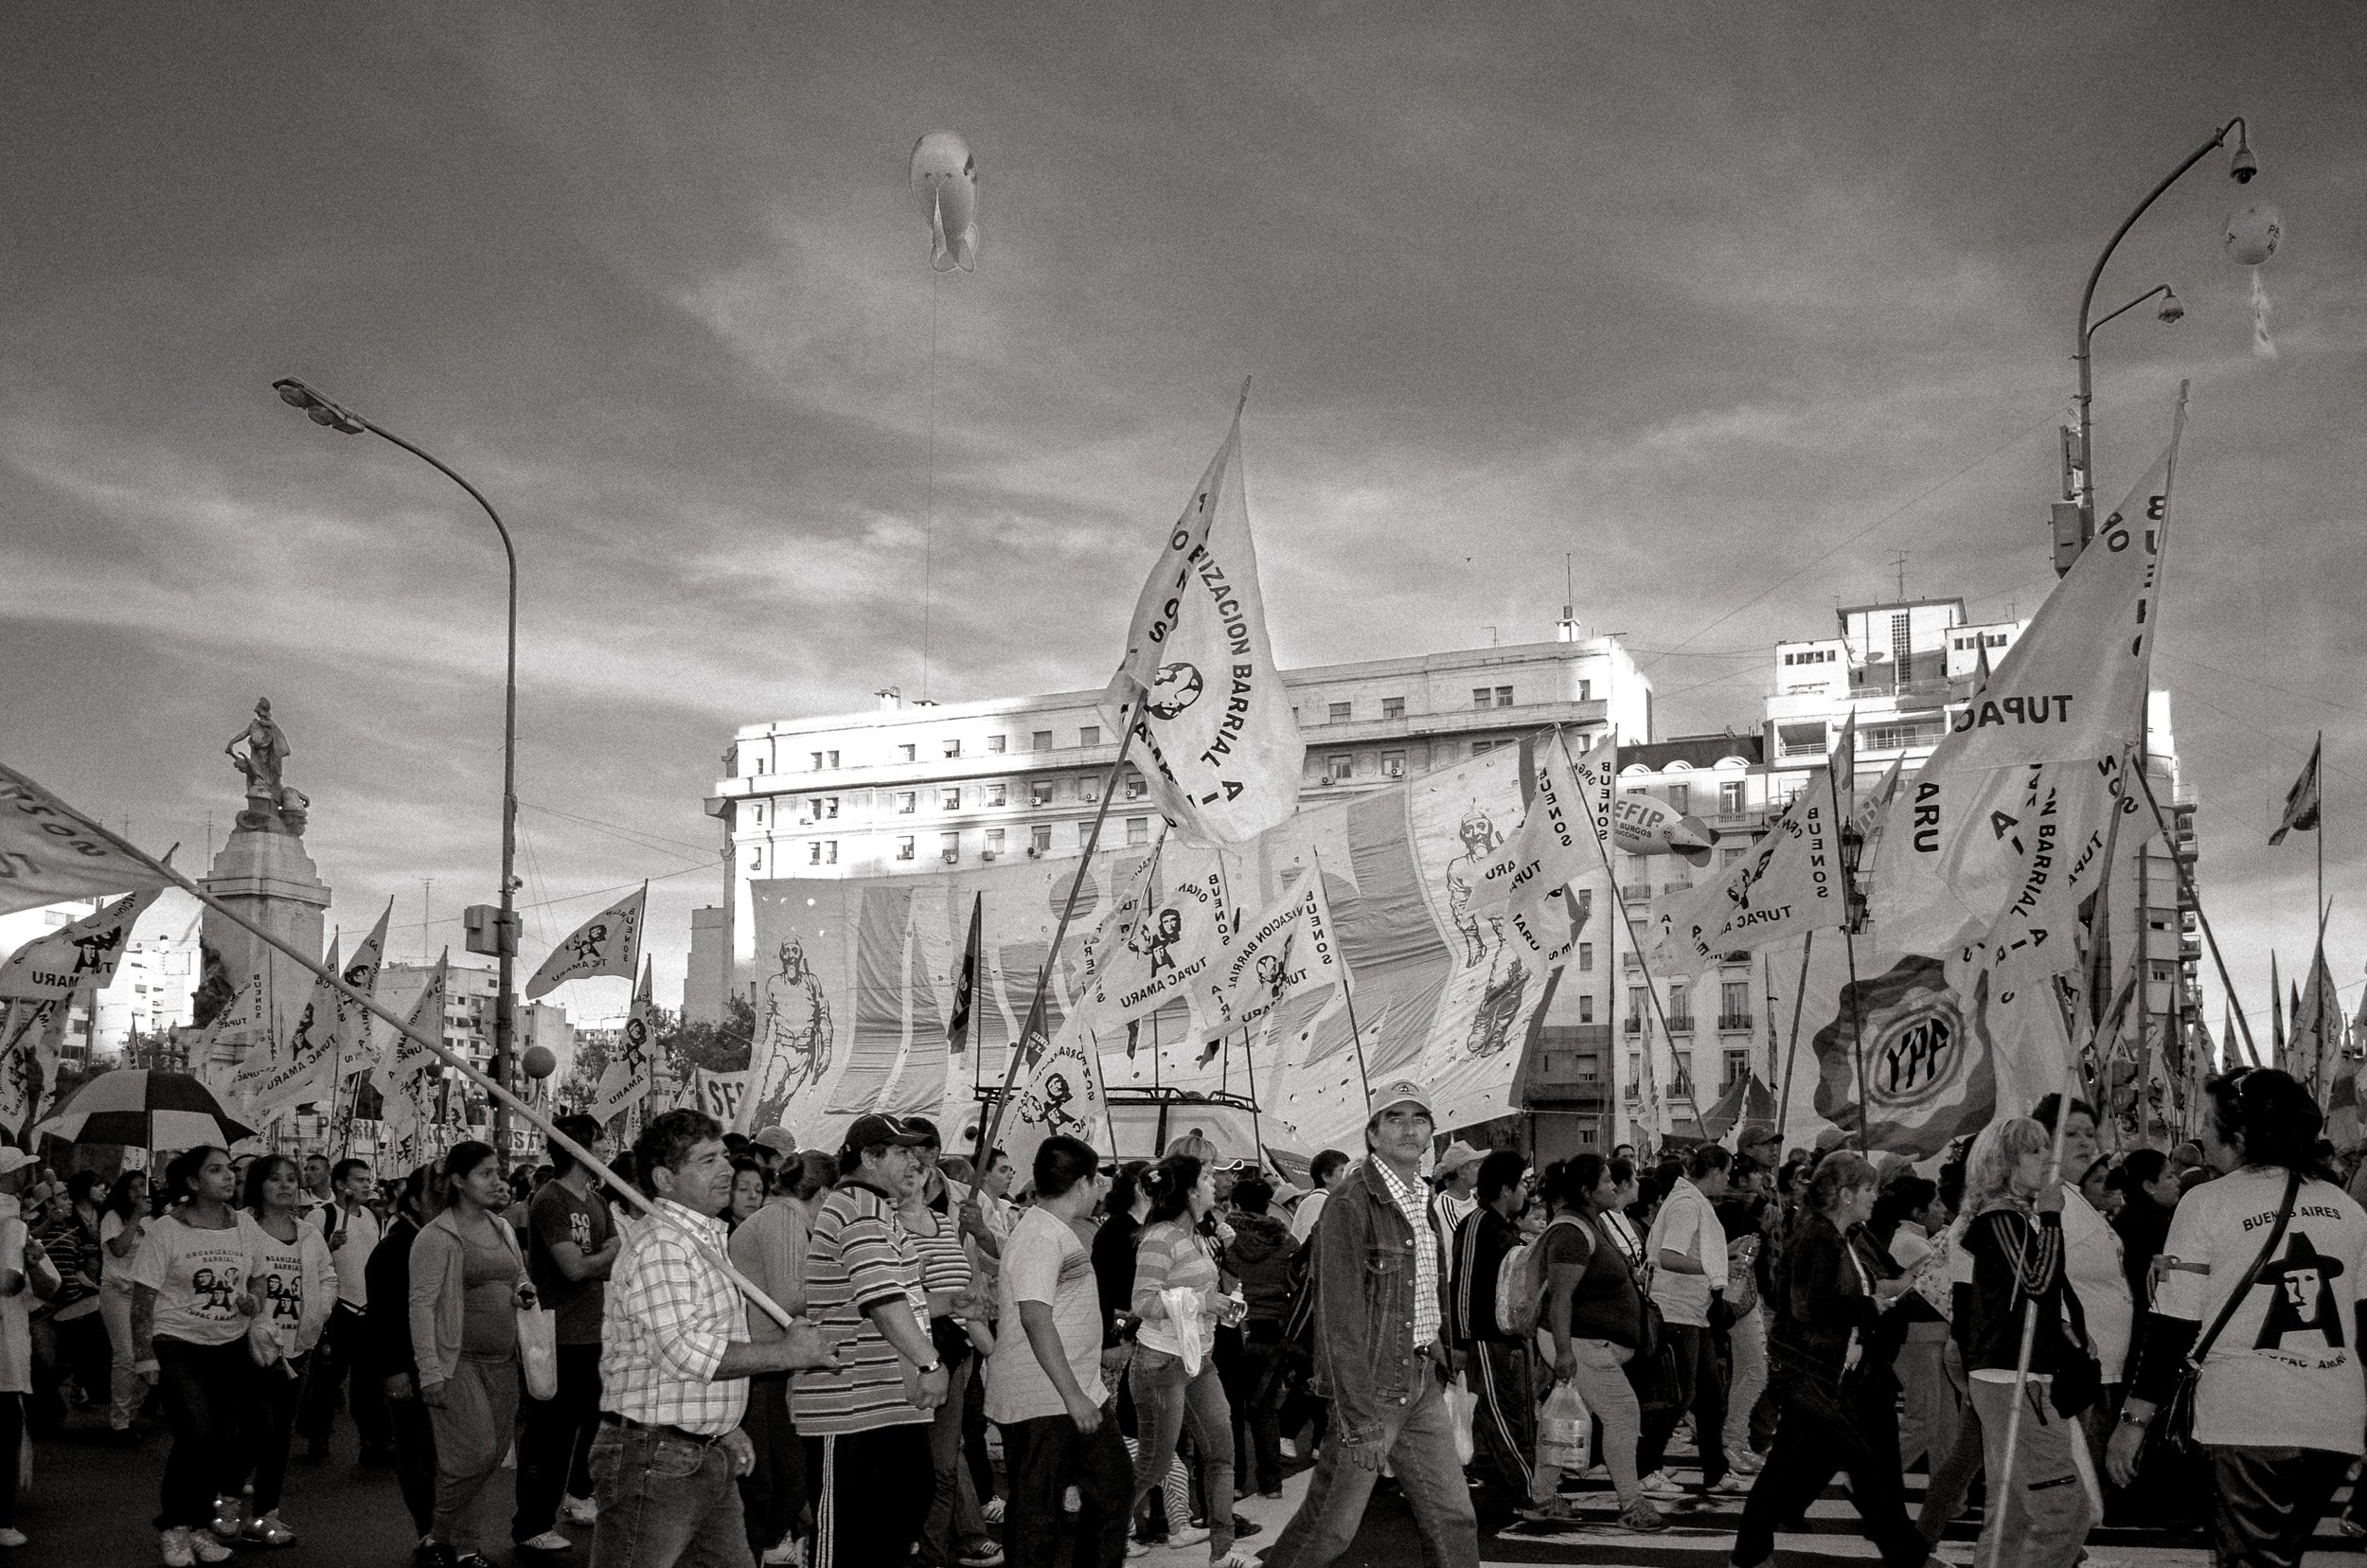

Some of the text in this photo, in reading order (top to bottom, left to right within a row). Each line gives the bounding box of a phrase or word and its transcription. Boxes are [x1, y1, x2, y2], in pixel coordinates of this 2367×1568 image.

[1200, 664, 1253, 768] BARRIAL
[1619, 823, 1653, 840] BURGOS
[2009, 824, 2057, 918] BARRIAL
[1886, 1017, 1950, 1094] YPF
[2242, 1205, 2341, 1232] BUENS AIRES
